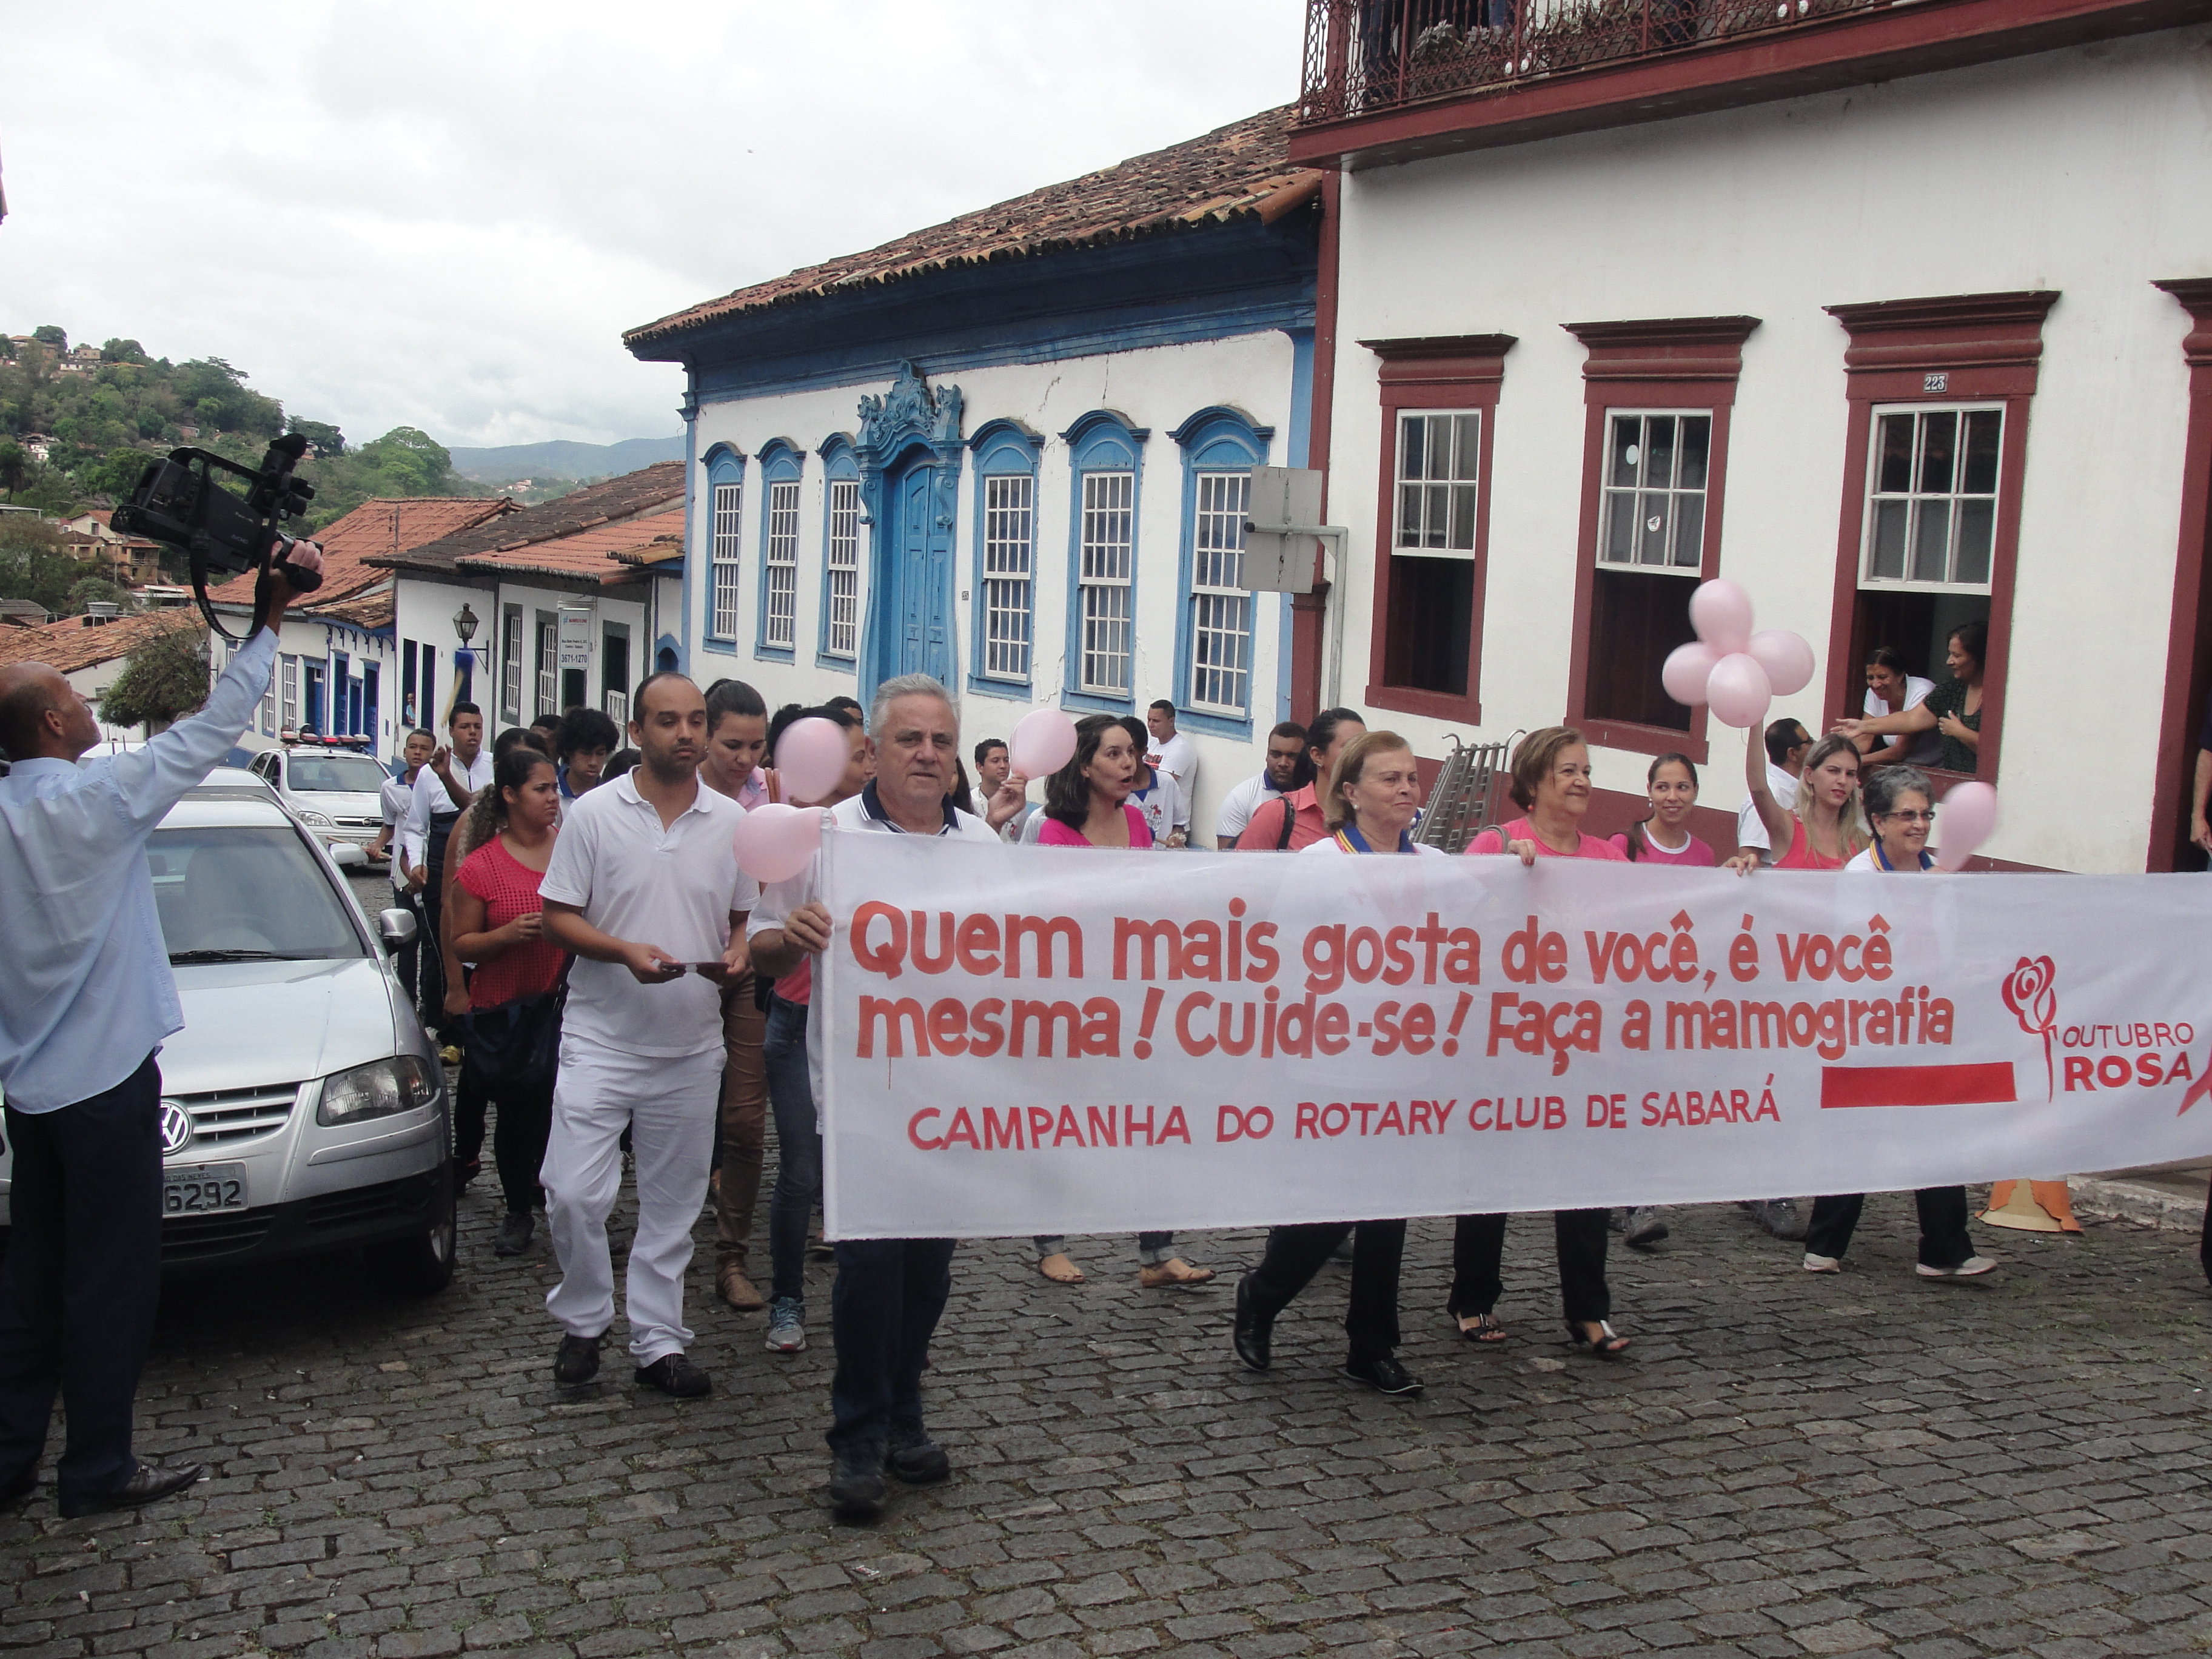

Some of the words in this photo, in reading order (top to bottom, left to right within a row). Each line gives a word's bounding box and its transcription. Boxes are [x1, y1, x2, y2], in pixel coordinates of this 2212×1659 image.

[1925, 375, 1946, 390] 223
[561, 654, 588, 663] 3671-1270
[850, 900, 1084, 980] Quem
[1112, 897, 1280, 984] mais
[1302, 911, 1481, 995] gosta
[1501, 914, 1568, 985] de
[1584, 909, 1717, 993] você,
[1729, 913, 1760, 982] é
[1776, 913, 1893, 983] você
[1486, 991, 1603, 1076] Faça
[1621, 999, 1651, 1051] a
[1666, 985, 1954, 1061] mamografia
[2062, 1022, 2194, 1048] OUTUBRO
[2063, 1051, 2193, 1092] ROSA
[908, 1104, 1191, 1151] CAMPANHA
[1216, 1103, 1274, 1142] DO
[1295, 1099, 1458, 1140] ROTARY
[1468, 1096, 1567, 1131] CLUB
[1586, 1093, 1627, 1129] DE
[1641, 1073, 1781, 1128] SABARÁ
[164, 1179, 242, 1212] 6292
